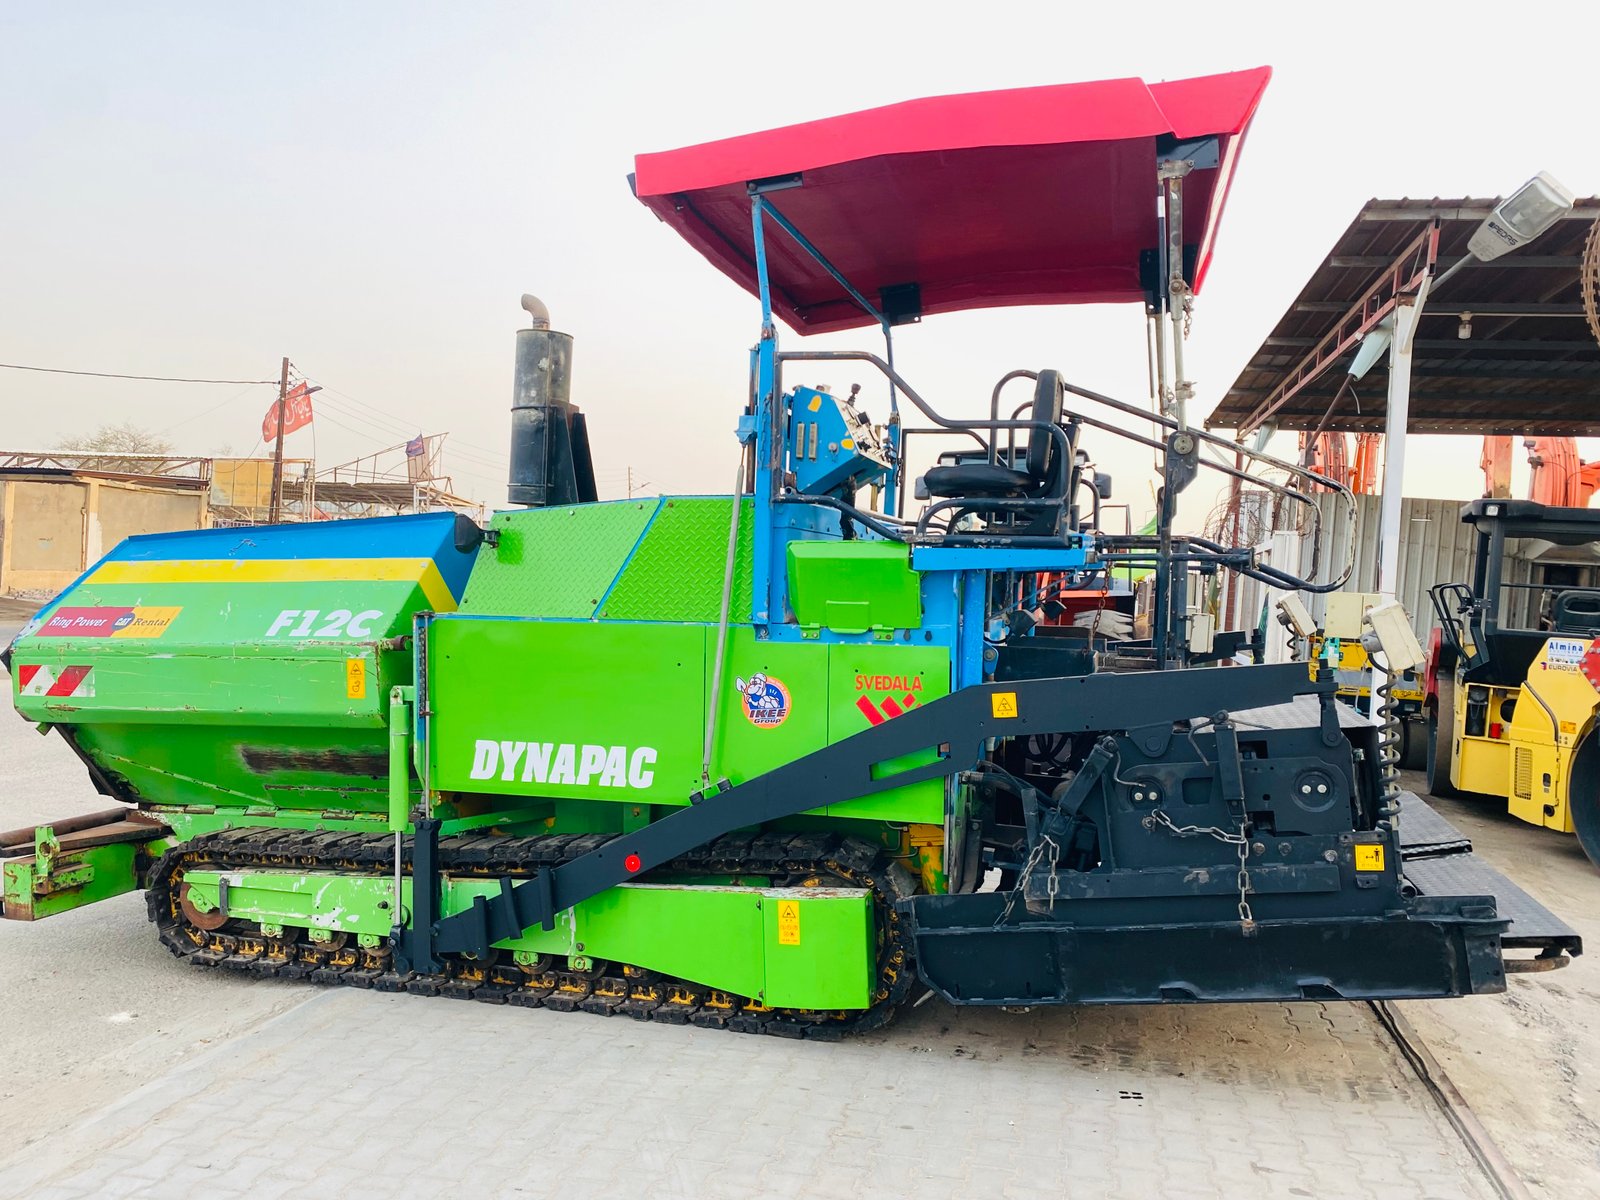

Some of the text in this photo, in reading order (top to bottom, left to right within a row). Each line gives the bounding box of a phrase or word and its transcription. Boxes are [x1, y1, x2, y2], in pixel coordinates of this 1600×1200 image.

[49, 616, 170, 629] Ring Power CAT Rental
[264, 609, 384, 638] F12C
[1549, 641, 1583, 652] Almina
[855, 674, 923, 692] SVEDALA
[749, 708, 787, 719] IKEE
[469, 739, 658, 789] DYNAPAC
